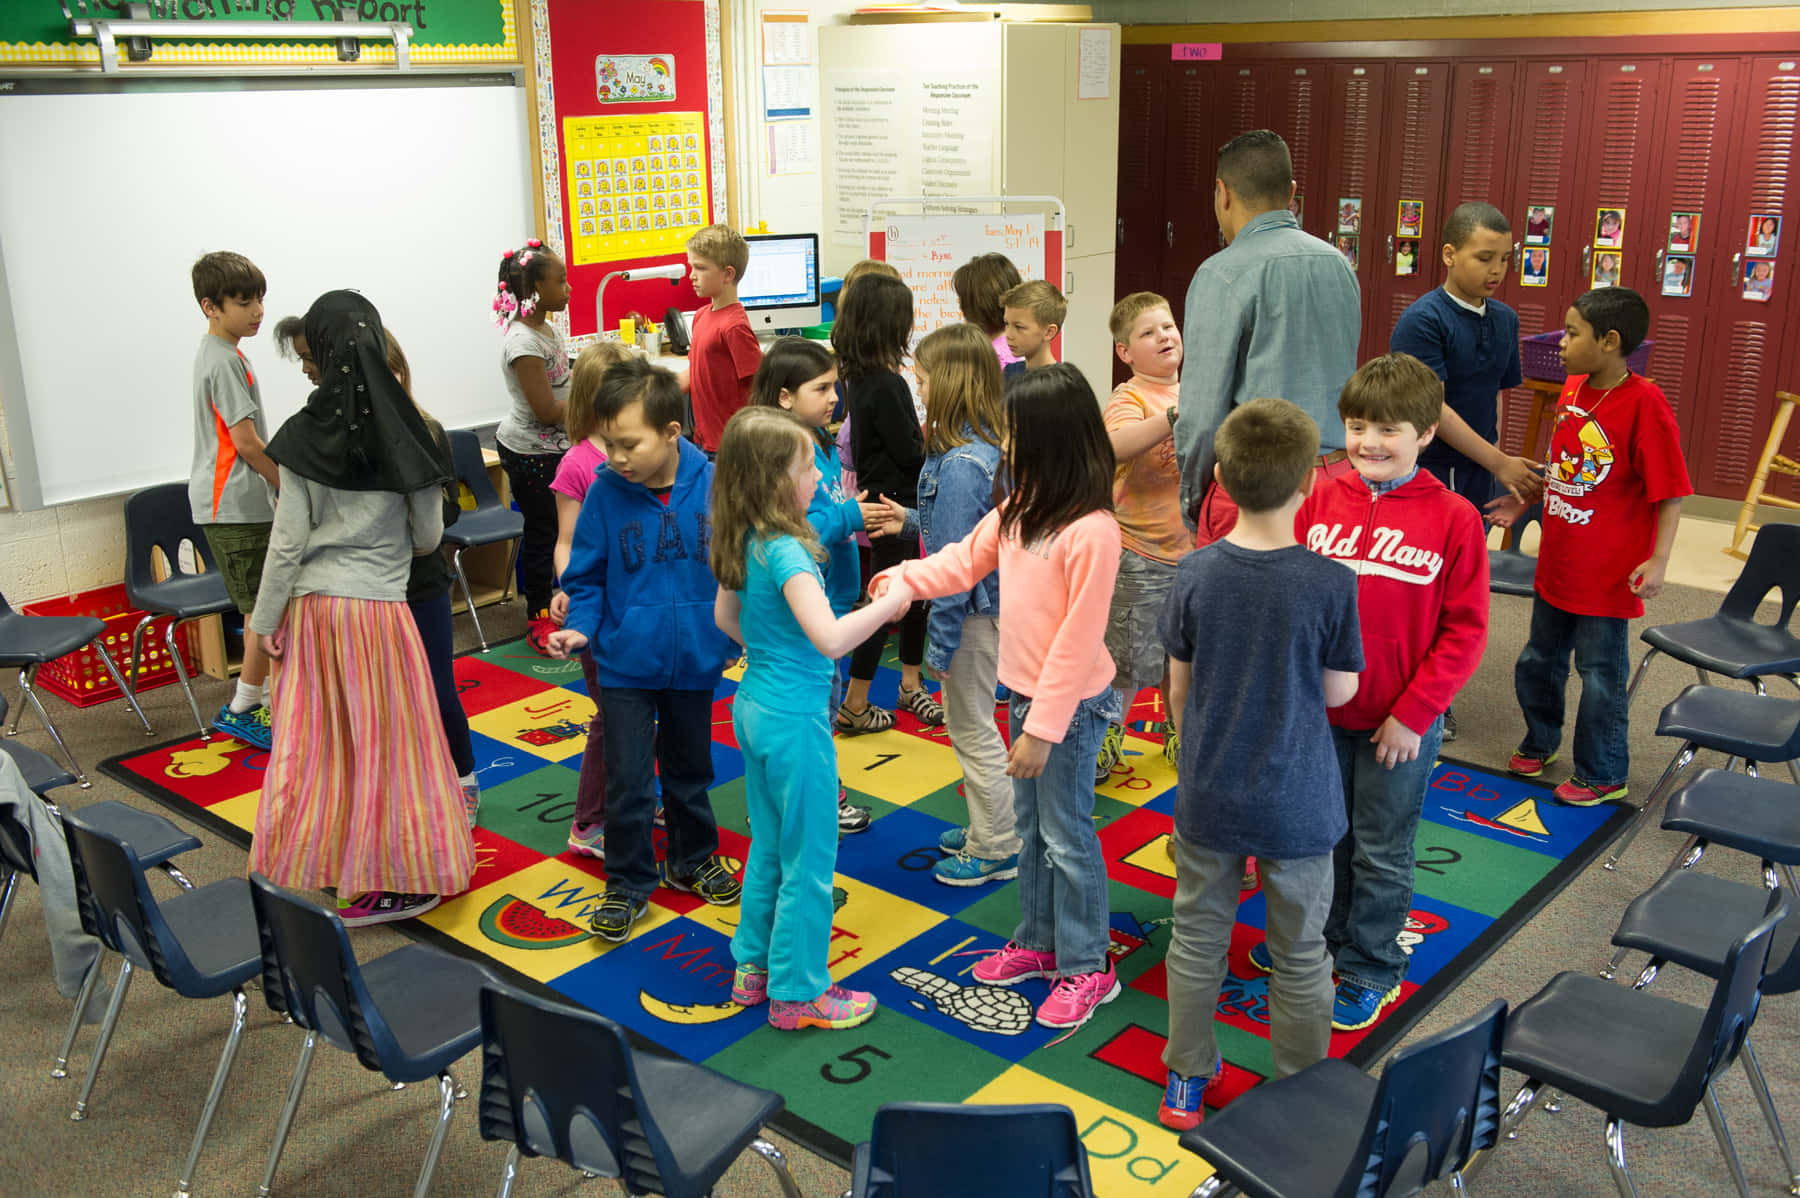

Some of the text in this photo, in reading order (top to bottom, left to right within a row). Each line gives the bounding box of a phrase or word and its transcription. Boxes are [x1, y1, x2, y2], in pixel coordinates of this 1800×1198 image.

[1183, 46, 1208, 57] two
[625, 71, 646, 88] May
[1005, 224, 1023, 238] May
[1548, 494, 1595, 525] BIRDS
[1307, 523, 1444, 574] Old Navy
[863, 753, 903, 771] 1
[1430, 771, 1500, 801] Bb
[516, 792, 577, 824] 10
[897, 847, 948, 872] 6
[1415, 846, 1462, 876] 2
[643, 932, 736, 988] Mm
[820, 1044, 893, 1085] 5
[1079, 1115, 1180, 1185] Dd
